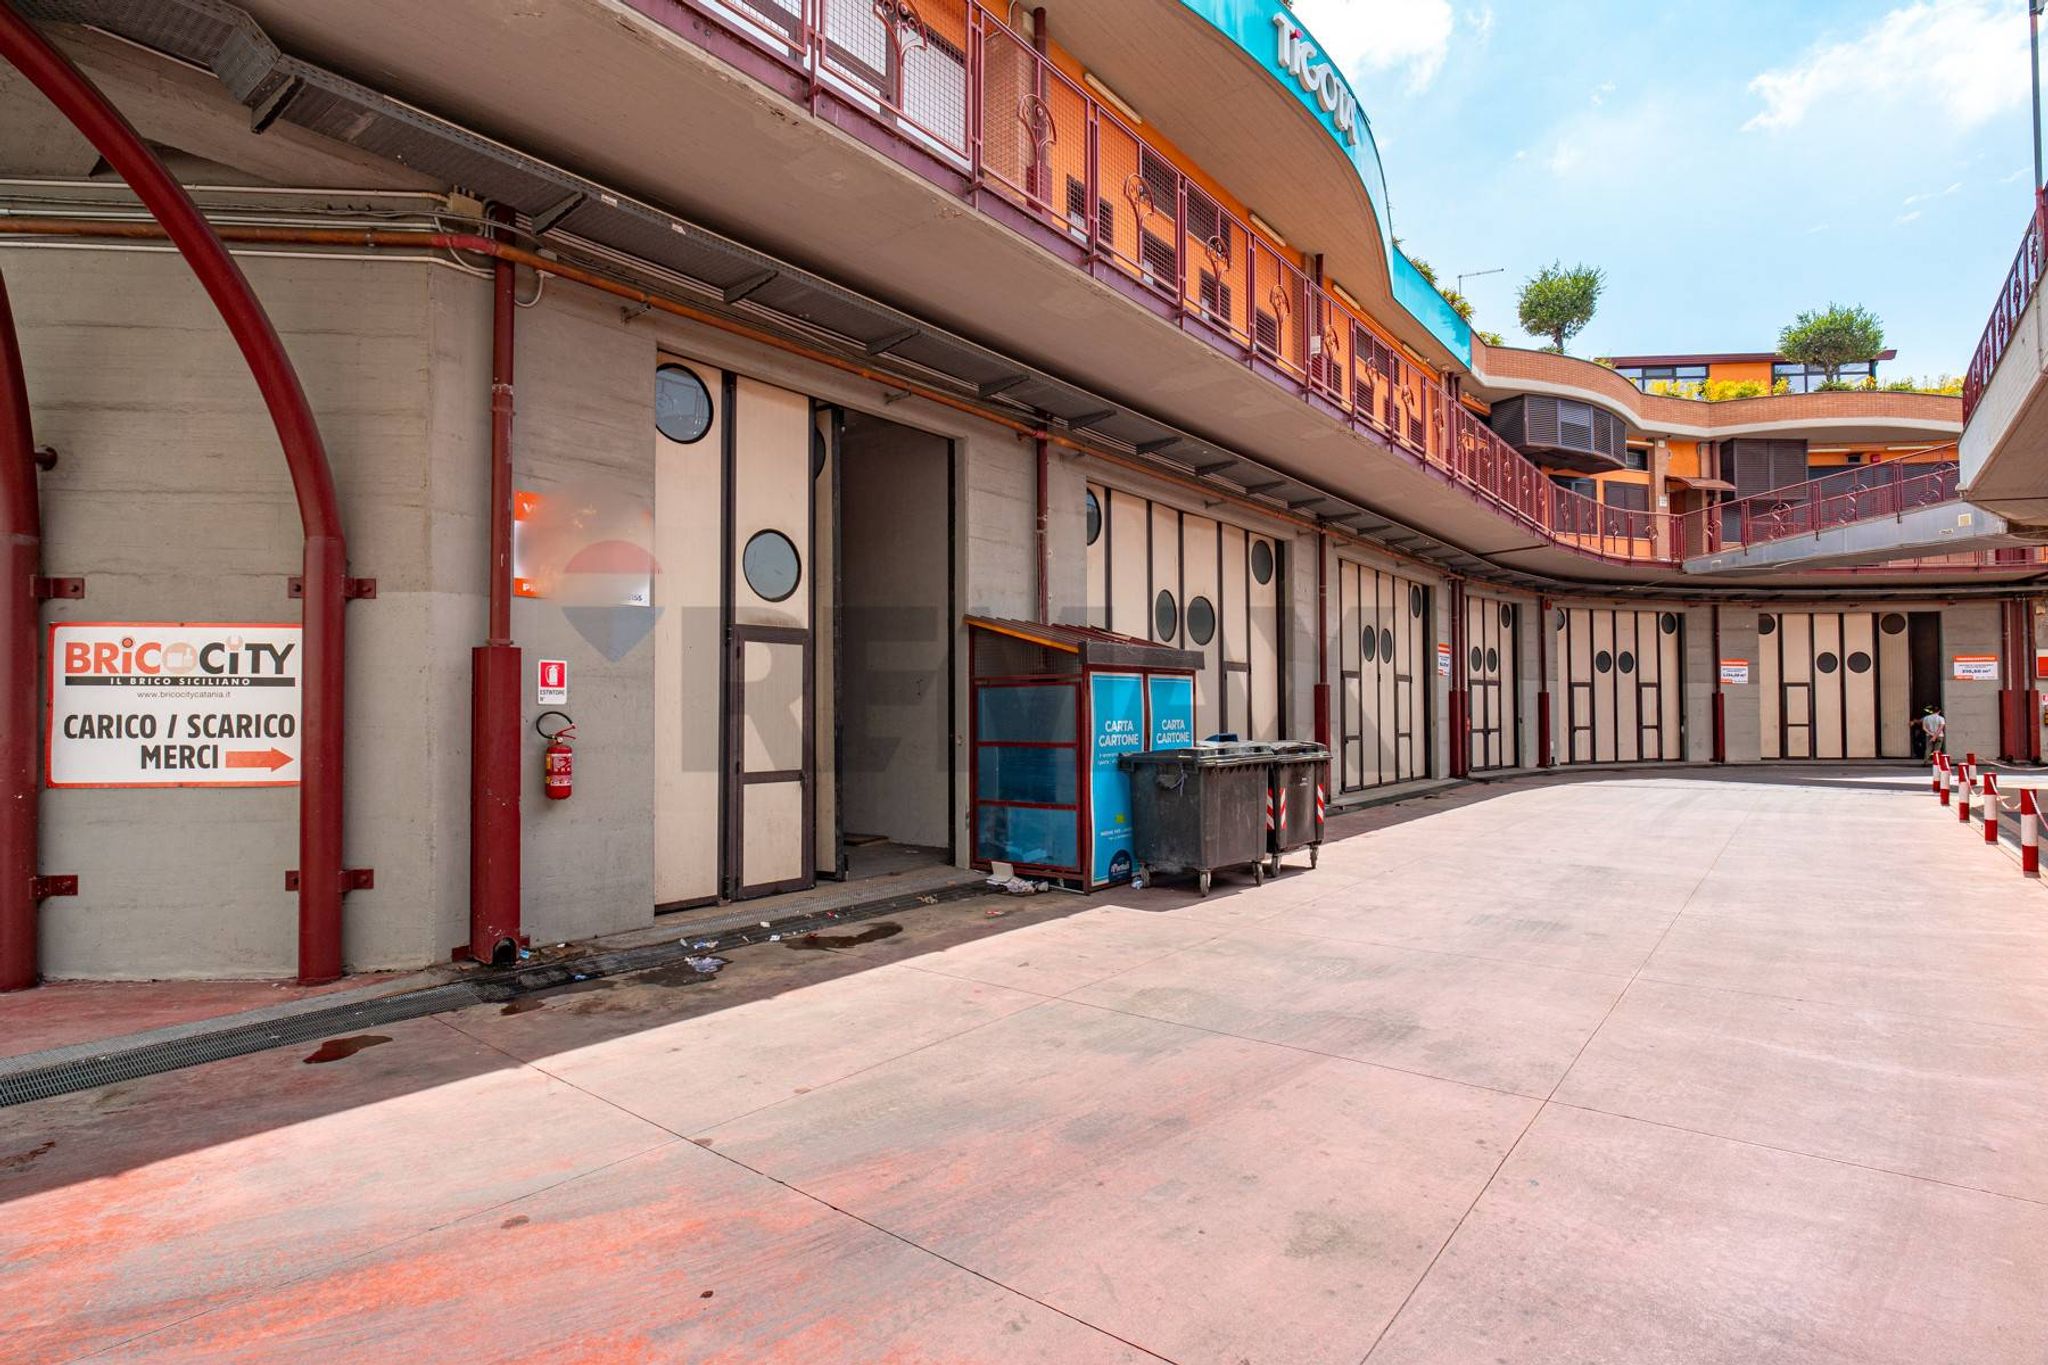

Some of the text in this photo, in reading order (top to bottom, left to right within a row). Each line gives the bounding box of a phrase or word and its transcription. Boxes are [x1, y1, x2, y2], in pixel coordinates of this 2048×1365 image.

[110, 677, 251, 687] IL BRICO SICILIANO
[137, 691, 231, 699] www.bricocitycatania.it
[63, 714, 296, 739] CARICO / SCARICO
[1105, 720, 1134, 732] CARTA
[1161, 719, 1186, 730] CARTA
[1099, 733, 1139, 746] CARTONE
[1156, 732, 1190, 744] CARTONE
[140, 745, 219, 769] MERCI
